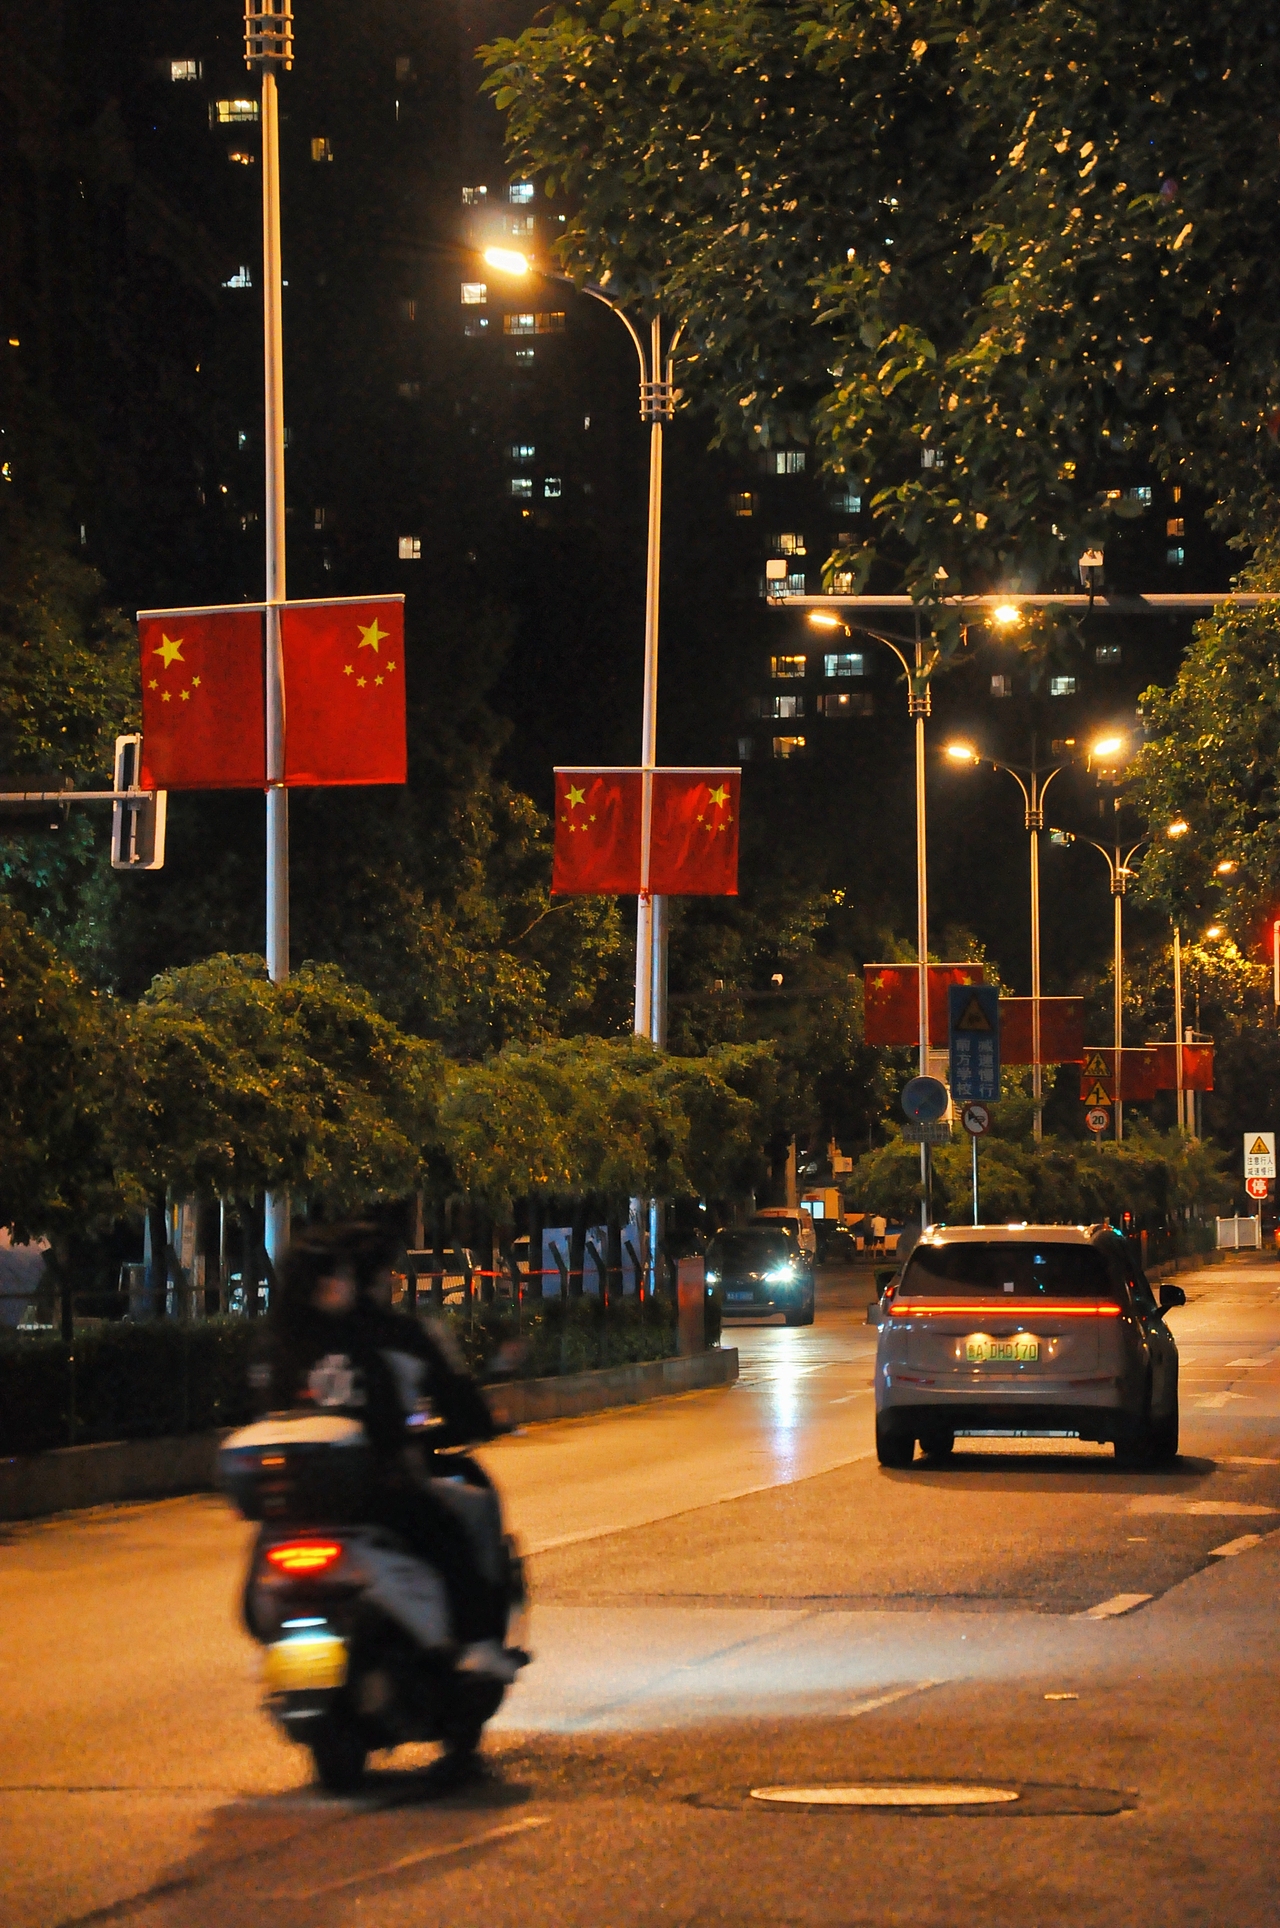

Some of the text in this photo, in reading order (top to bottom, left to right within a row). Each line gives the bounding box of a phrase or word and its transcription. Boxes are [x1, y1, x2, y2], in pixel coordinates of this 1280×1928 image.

[956, 1039, 972, 1096] 前方学校
[978, 1039, 994, 1097] 减速慢行
[1092, 1115, 1104, 1125] 20
[1247, 1157, 1273, 1166] 注意行人
[1247, 1167, 1274, 1176] 减速慢行
[1252, 1179, 1267, 1194] 停
